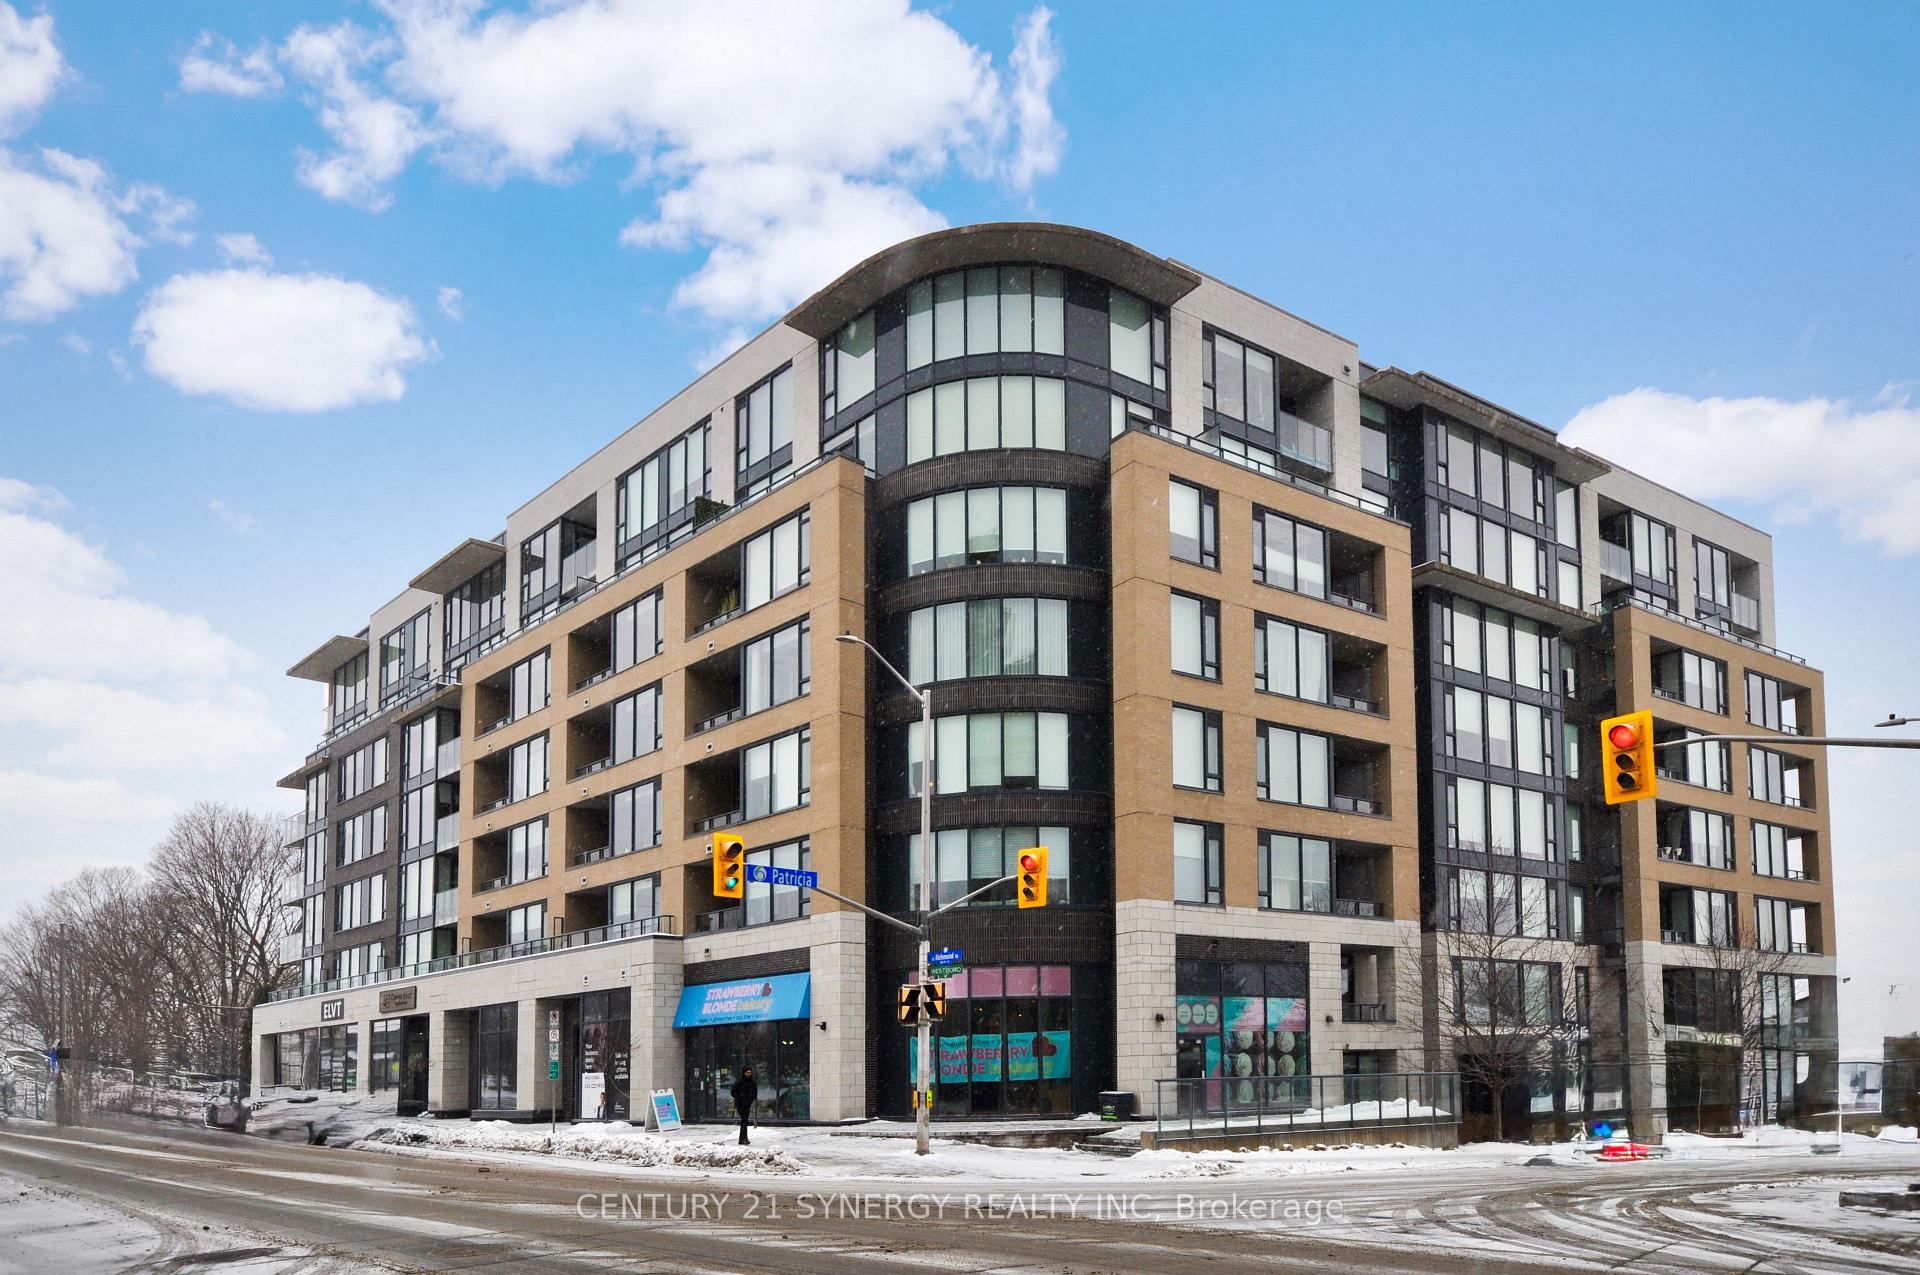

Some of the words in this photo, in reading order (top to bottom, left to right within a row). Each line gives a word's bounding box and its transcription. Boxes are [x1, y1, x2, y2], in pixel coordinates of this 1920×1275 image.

[772, 868, 812, 887] Patricia
[931, 966, 962, 974] WESTBORO
[705, 983, 763, 1000] STRAWBERRY
[323, 1001, 342, 1019] ELVT
[702, 1000, 738, 1014] BLONDE
[928, 1046, 1028, 1061] TRAWBERRY
[929, 1062, 986, 1076] ONDE
